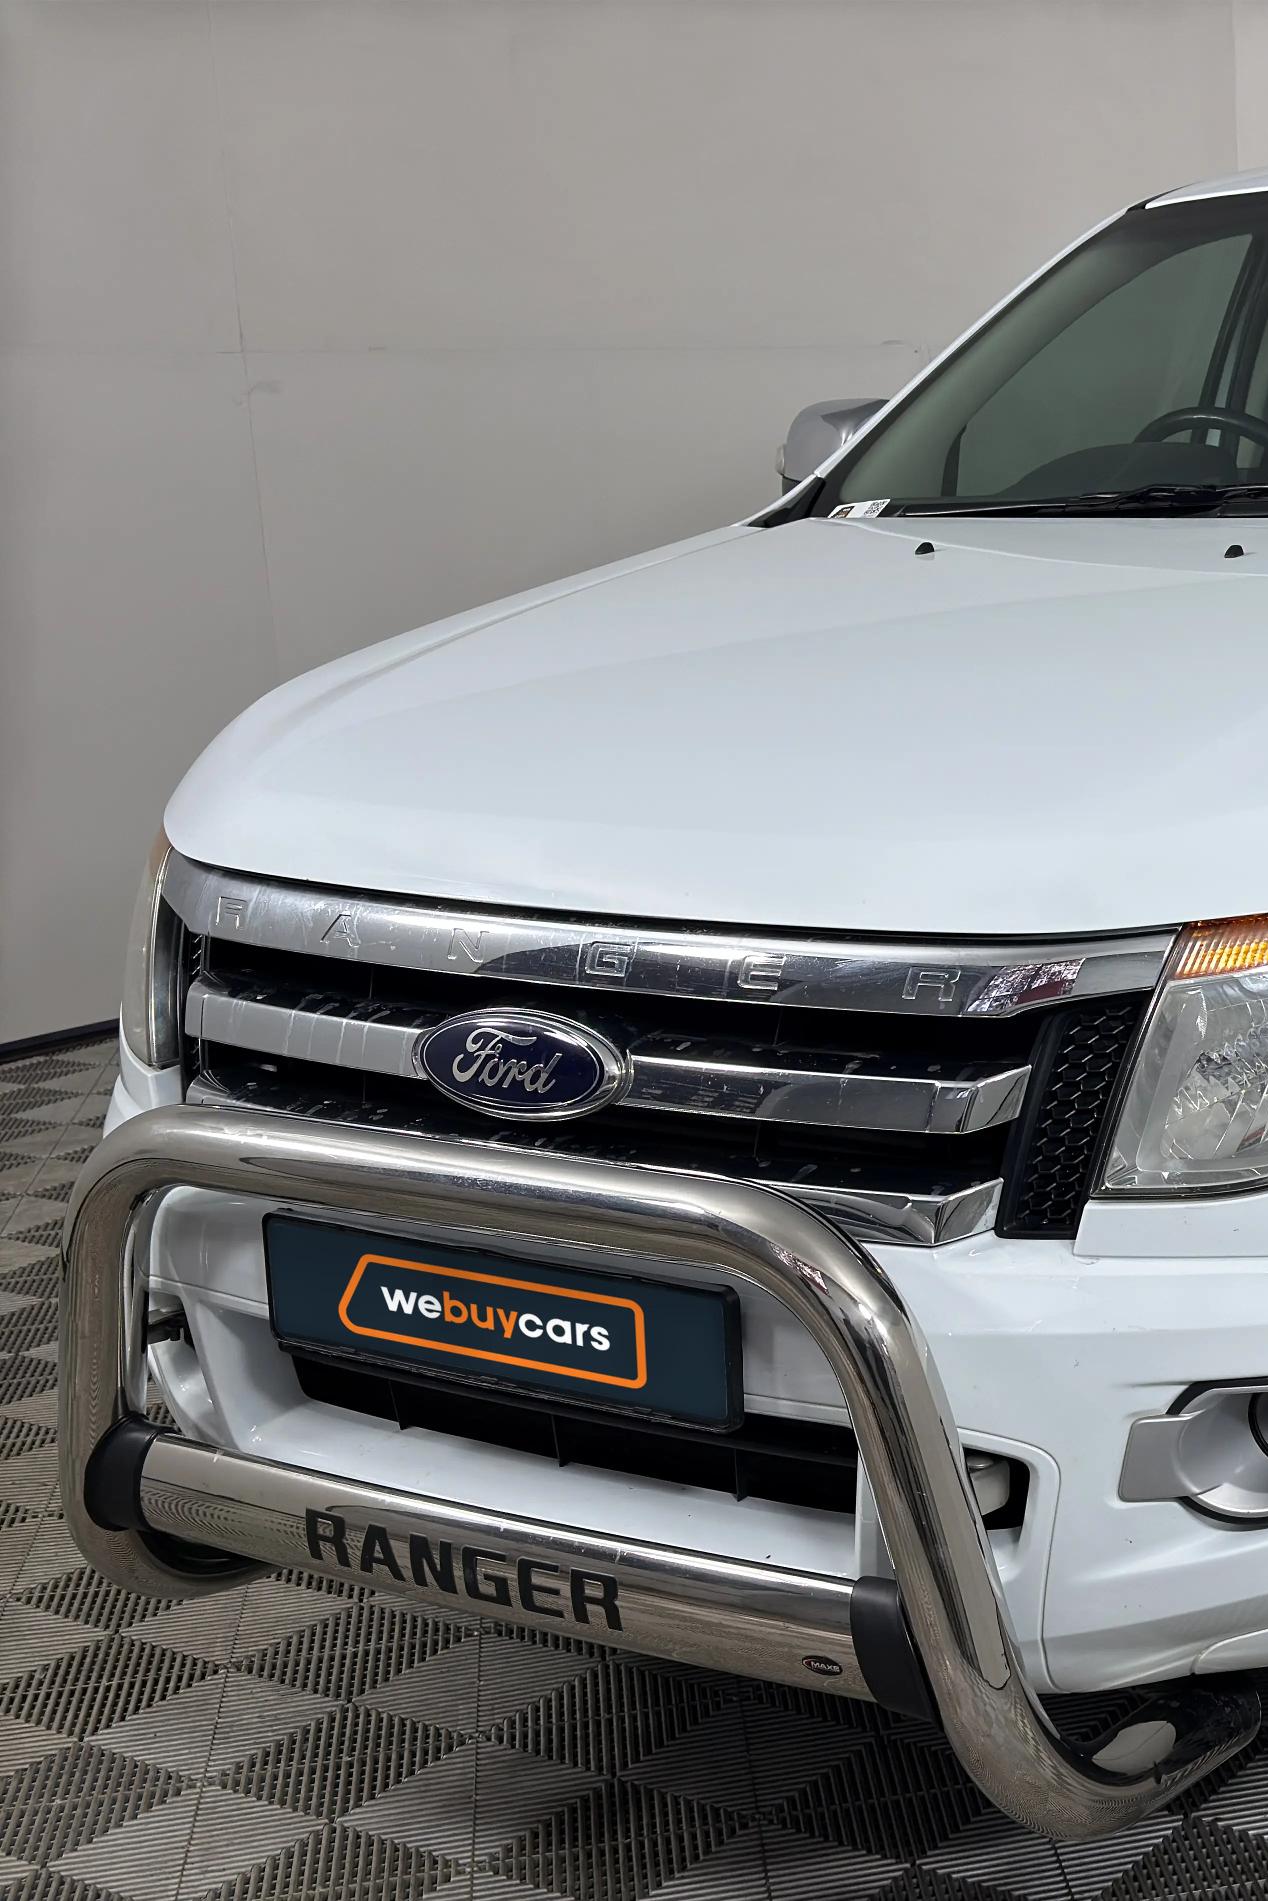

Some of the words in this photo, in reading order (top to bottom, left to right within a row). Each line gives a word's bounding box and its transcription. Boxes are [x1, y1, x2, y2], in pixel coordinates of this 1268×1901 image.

[214, 895, 962, 1003] RANGER
[452, 1027, 563, 1094] Ford
[380, 1285, 611, 1351] webuycars
[304, 1506, 624, 1632] RANGER
